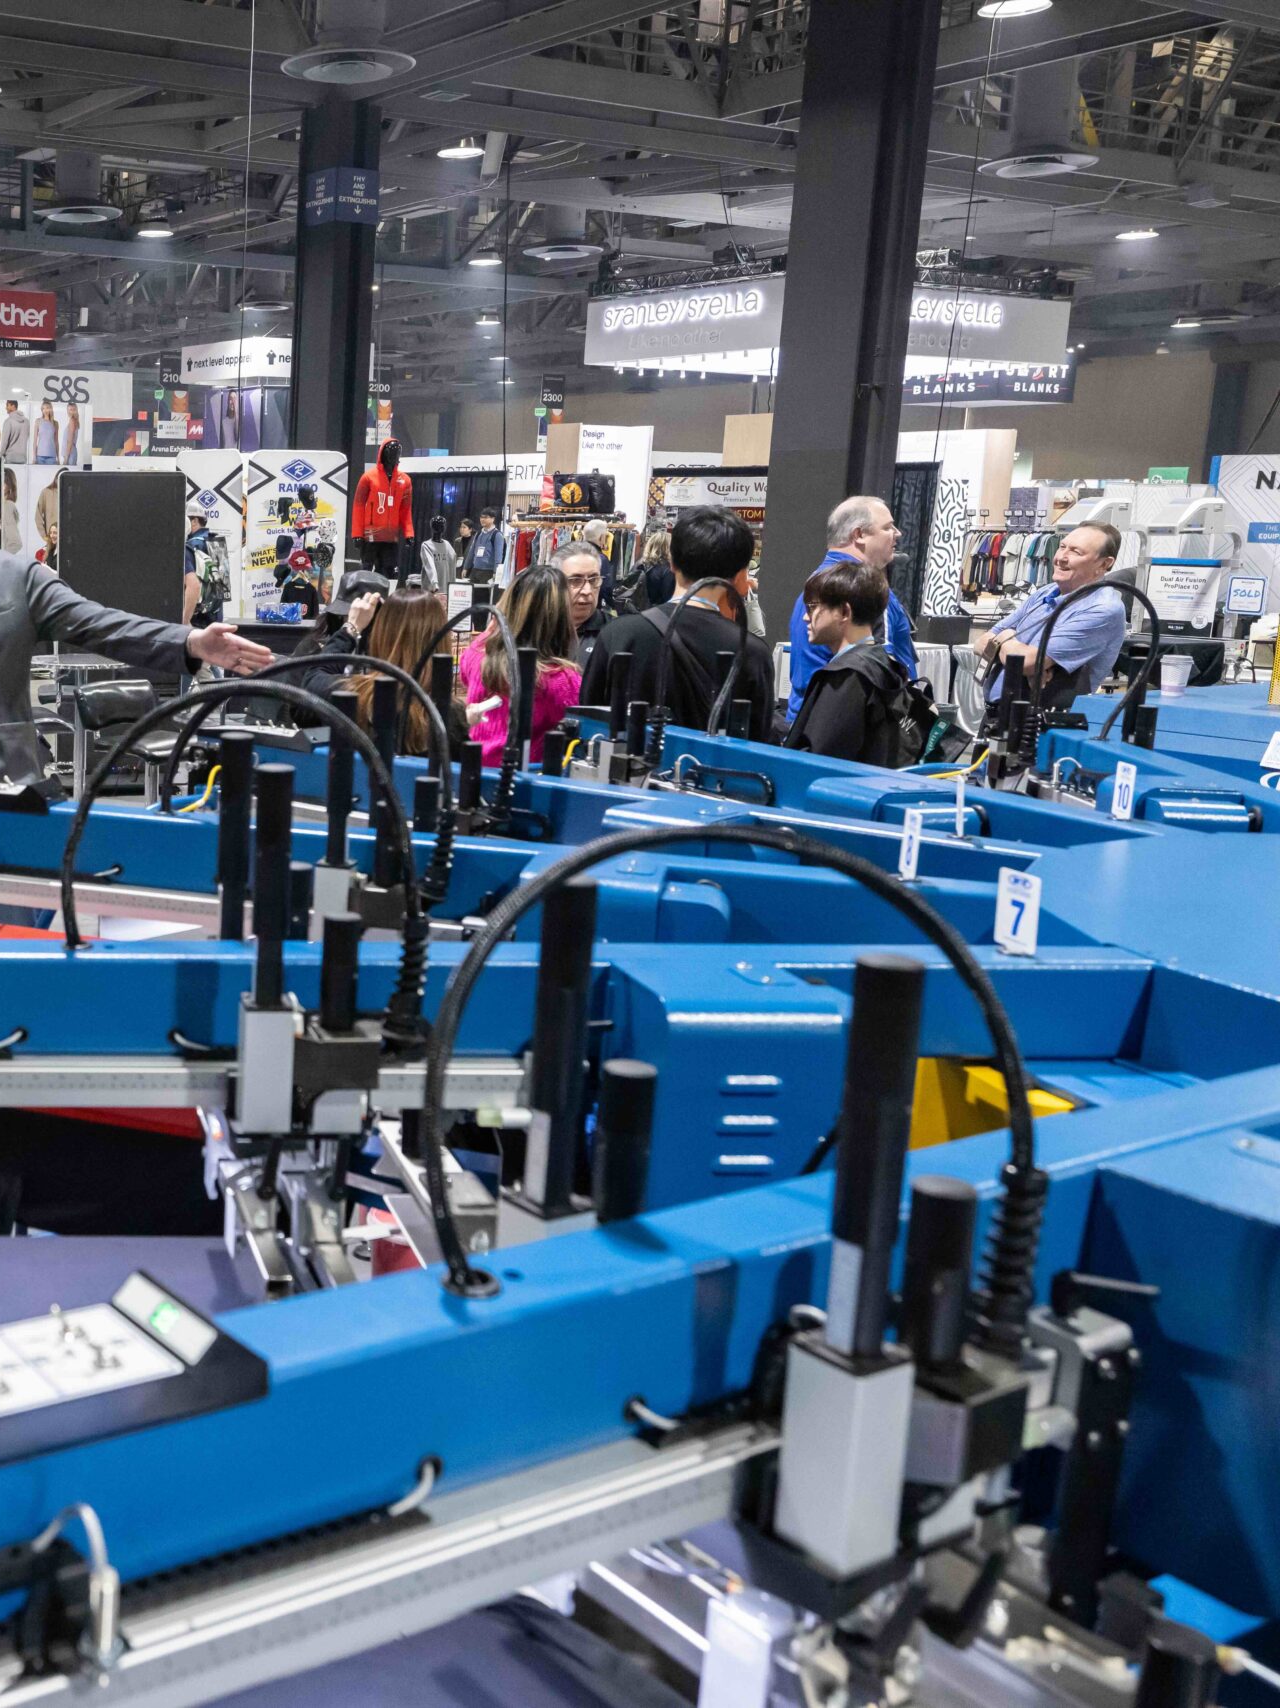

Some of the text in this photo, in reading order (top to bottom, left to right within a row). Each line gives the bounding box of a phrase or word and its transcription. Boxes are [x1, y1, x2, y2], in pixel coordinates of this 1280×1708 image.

[338, 195, 377, 205] EXTINGUISHER
[4, 339, 12, 348] to
[14, 339, 30, 349] Film
[193, 359, 208, 368] next
[209, 355, 224, 366] level
[278, 354, 291, 363] ne
[162, 373, 180, 382] 210
[43, 375, 90, 403] S&S
[369, 383, 390, 392] 2200
[913, 382, 976, 395] BLANKS
[1014, 383, 1060, 394] BLANKS
[542, 393, 563, 402] 2300
[583, 430, 605, 439] Design
[502, 465, 545, 480] ERITA
[1256, 470, 1280, 490] N
[707, 482, 750, 495] Quality
[204, 510, 219, 519] MCO
[735, 510, 761, 518] STOM
[266, 527, 285, 535] Quick
[1258, 532, 1280, 540] EQUIP
[250, 547, 277, 558] WHAT'S
[252, 556, 277, 567] NEW
[252, 581, 274, 590] Puffer
[253, 587, 282, 598] Jackets
[1233, 589, 1261, 598] SOLD
[1118, 782, 1130, 810] 10
[1011, 899, 1025, 936] 7
